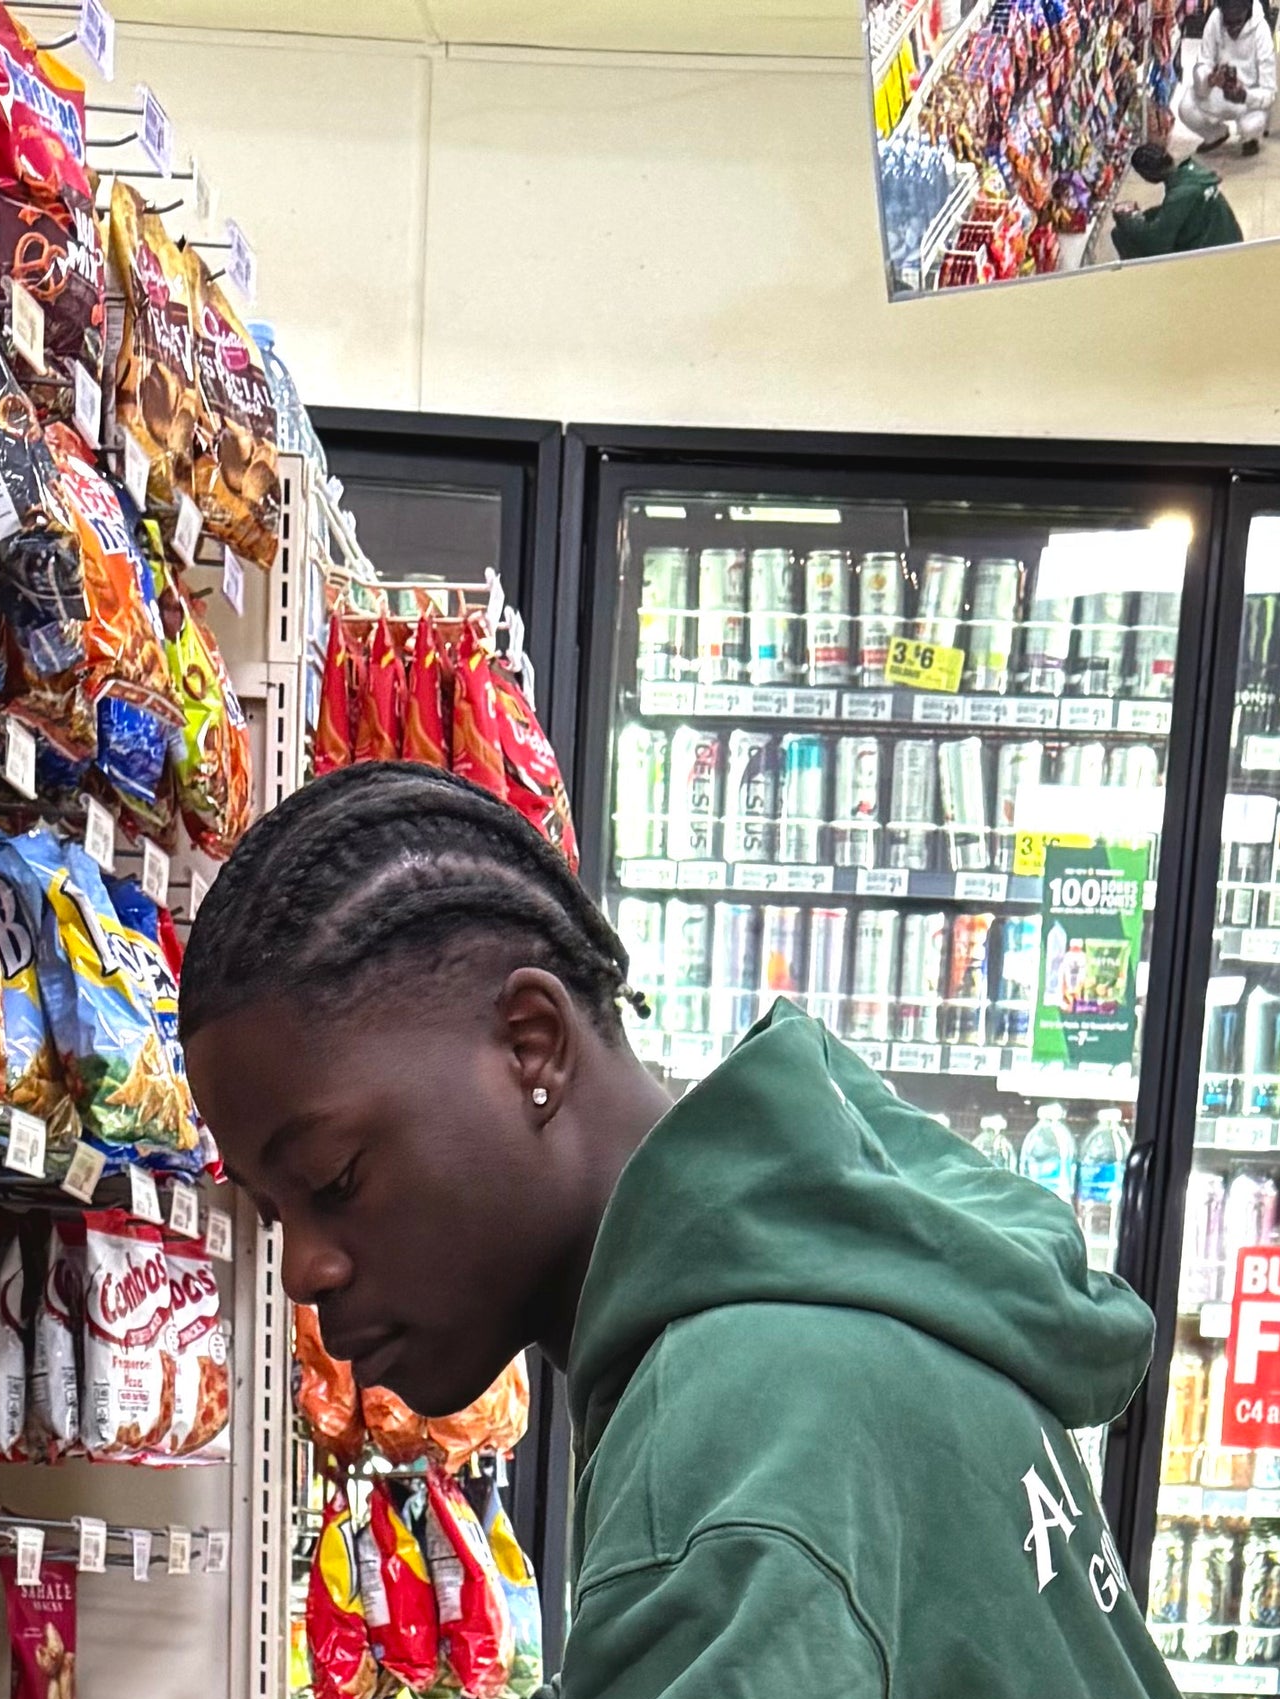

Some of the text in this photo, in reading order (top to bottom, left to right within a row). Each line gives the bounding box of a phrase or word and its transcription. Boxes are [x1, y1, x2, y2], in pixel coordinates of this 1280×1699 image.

[892, 642, 907, 667] 3
[1049, 877, 1101, 907] 100
[1235, 1401, 1265, 1426] C4
[20, 1583, 72, 1600] SAHALE
